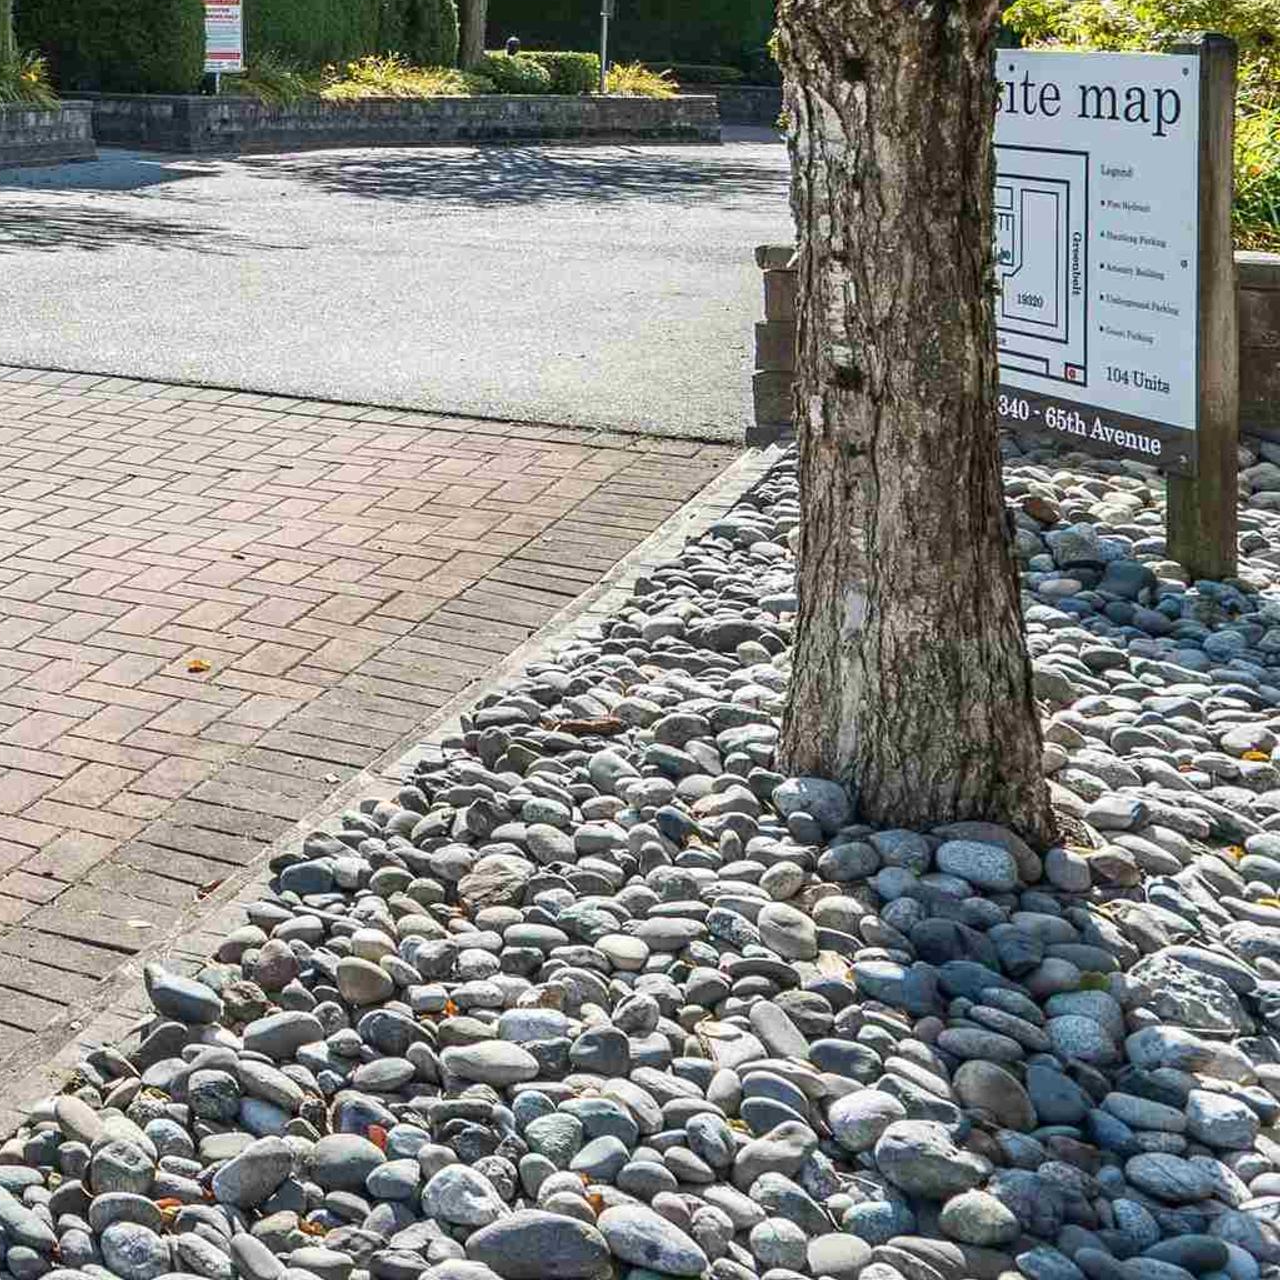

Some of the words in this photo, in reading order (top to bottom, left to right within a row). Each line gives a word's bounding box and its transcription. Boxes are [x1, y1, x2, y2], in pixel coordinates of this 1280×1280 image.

[1078, 83, 1182, 138] map
[1100, 164, 1133, 179] Legend
[1140, 235, 1168, 250] Parking
[1072, 231, 1083, 297] Greenbelt
[1106, 293, 1150, 311] Underground
[1151, 300, 1180, 317] Parking
[1106, 366, 1128, 385] 104
[1133, 370, 1171, 394] Units
[1044, 406, 1088, 438] 65th
[1089, 416, 1163, 456] Avenue
